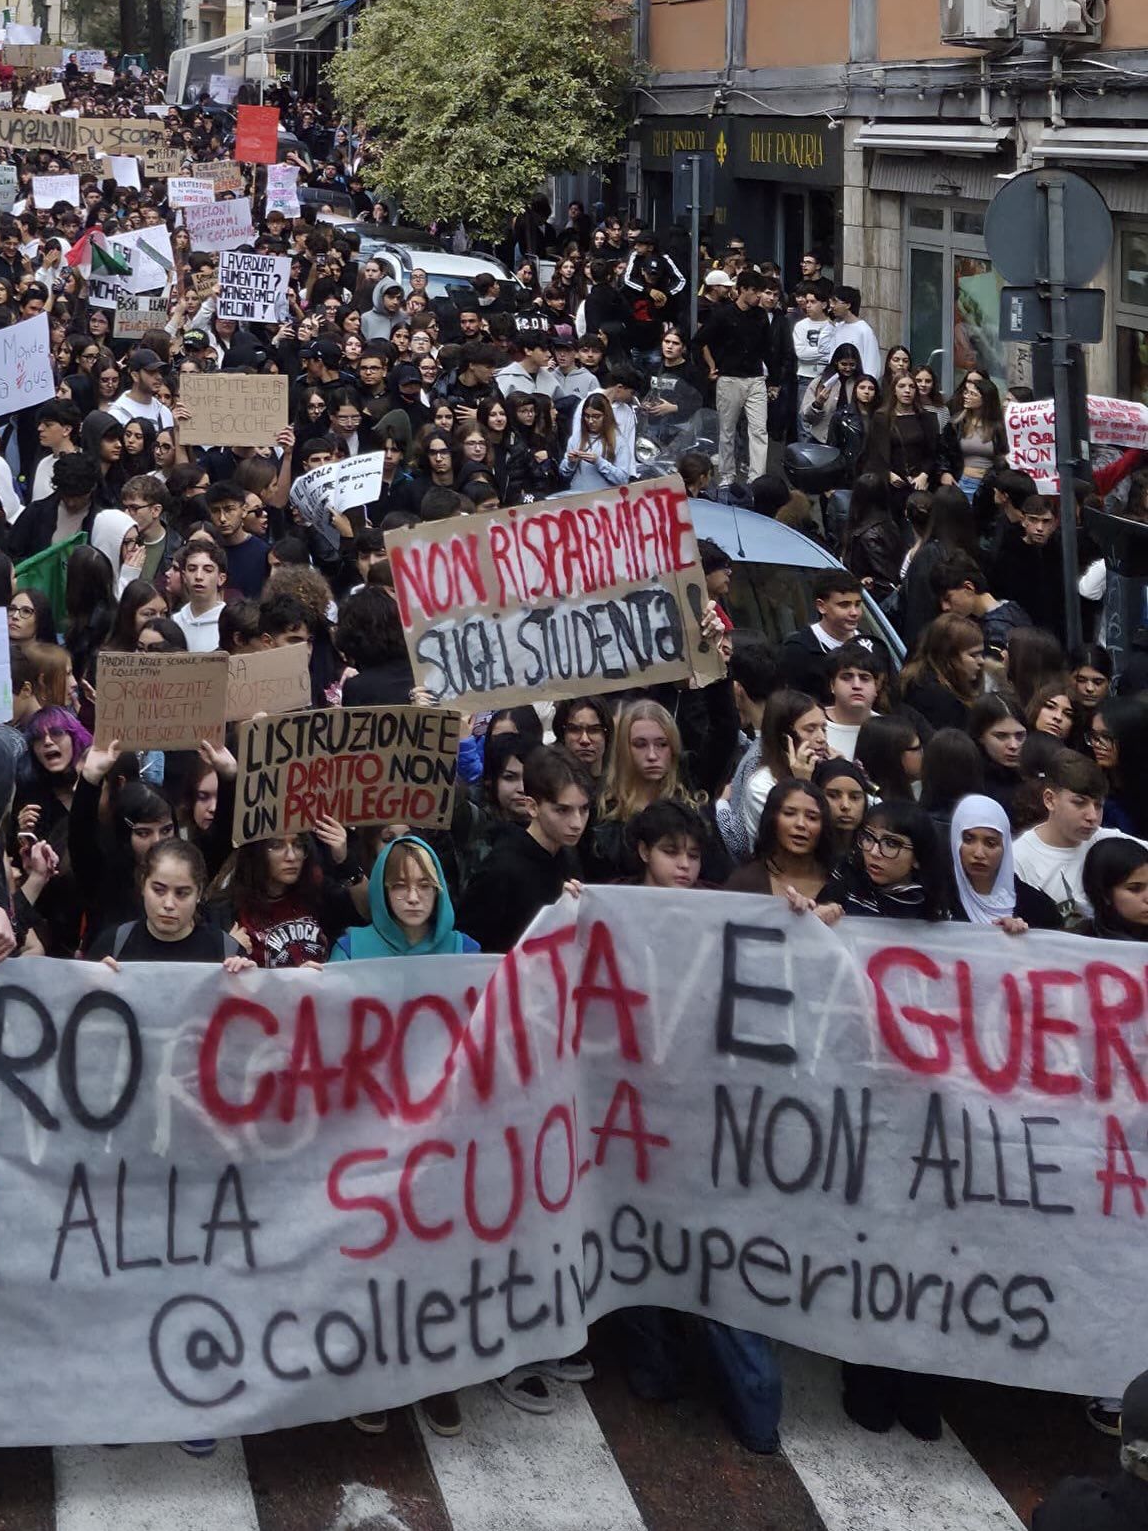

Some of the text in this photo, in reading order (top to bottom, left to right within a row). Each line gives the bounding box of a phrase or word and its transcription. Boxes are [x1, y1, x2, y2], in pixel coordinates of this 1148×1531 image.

[2, 333, 45, 366] Monde
[182, 376, 250, 395] RIEMPITE
[244, 396, 282, 412] MENO
[210, 412, 277, 434] BOCCHE
[1008, 413, 1039, 431] CHE
[1013, 447, 1051, 466] NON
[390, 486, 697, 628] NON RISPARMIATE
[100, 655, 135, 667] ANDATE
[416, 611, 507, 700] SUGLI
[102, 679, 213, 702] ORGANIZZATE
[100, 701, 202, 720] LA RIVOLTA
[243, 750, 456, 808] UN DIRITTO NON
[242, 801, 278, 840] UN
[289, 923, 321, 943] ROCK
[198, 919, 648, 1127] CAROVITA
[716, 919, 798, 1067] E
[866, 945, 1148, 1105] GUER
[51, 1158, 260, 1282] ALLA
[710, 1083, 872, 1207] NON
[908, 1091, 1076, 1216] ALLE
[1094, 1113, 1148, 1218] A
